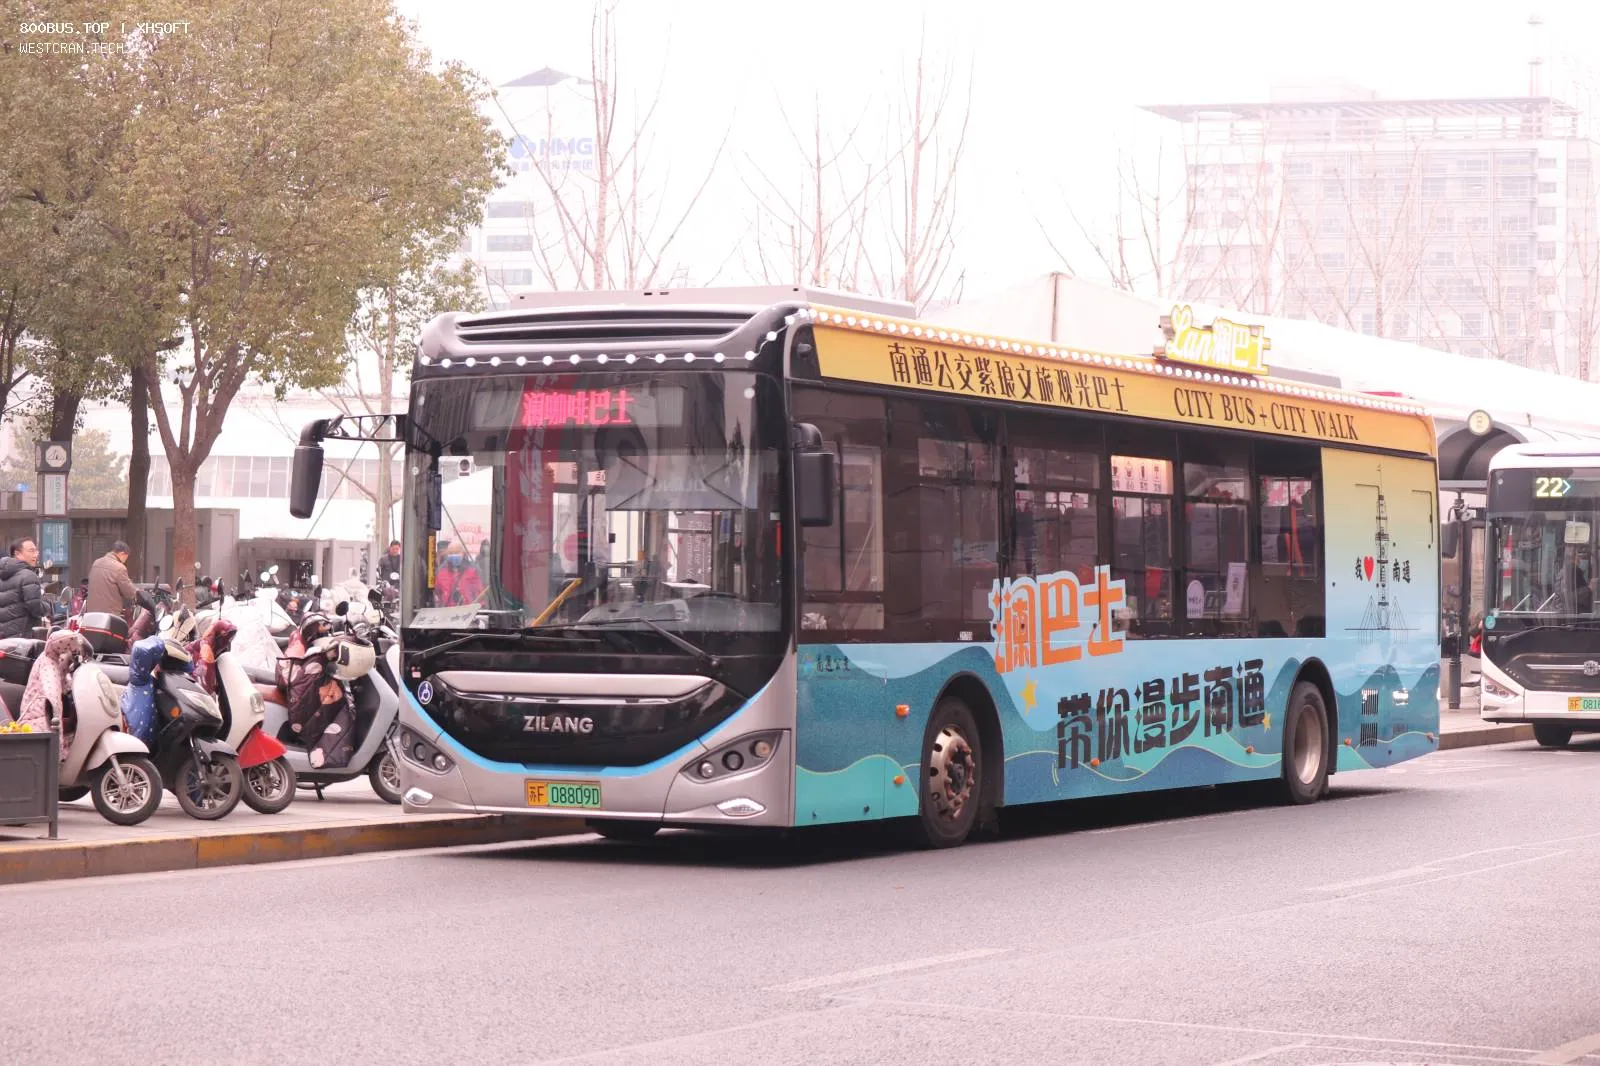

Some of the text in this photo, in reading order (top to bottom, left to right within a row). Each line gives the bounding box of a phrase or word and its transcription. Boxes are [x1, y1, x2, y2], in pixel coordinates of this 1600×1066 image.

[887, 342, 1129, 412] 南通公交紫琅文旅观光巴士
[1173, 387, 1215, 420] CITY
[1311, 408, 1359, 441] WALK
[1535, 477, 1563, 497] 22
[992, 572, 1124, 674] 澜巴士
[522, 715, 594, 733] ZILANG
[1056, 658, 1266, 769] 带你漫步南通
[551, 786, 600, 805] 08809D
